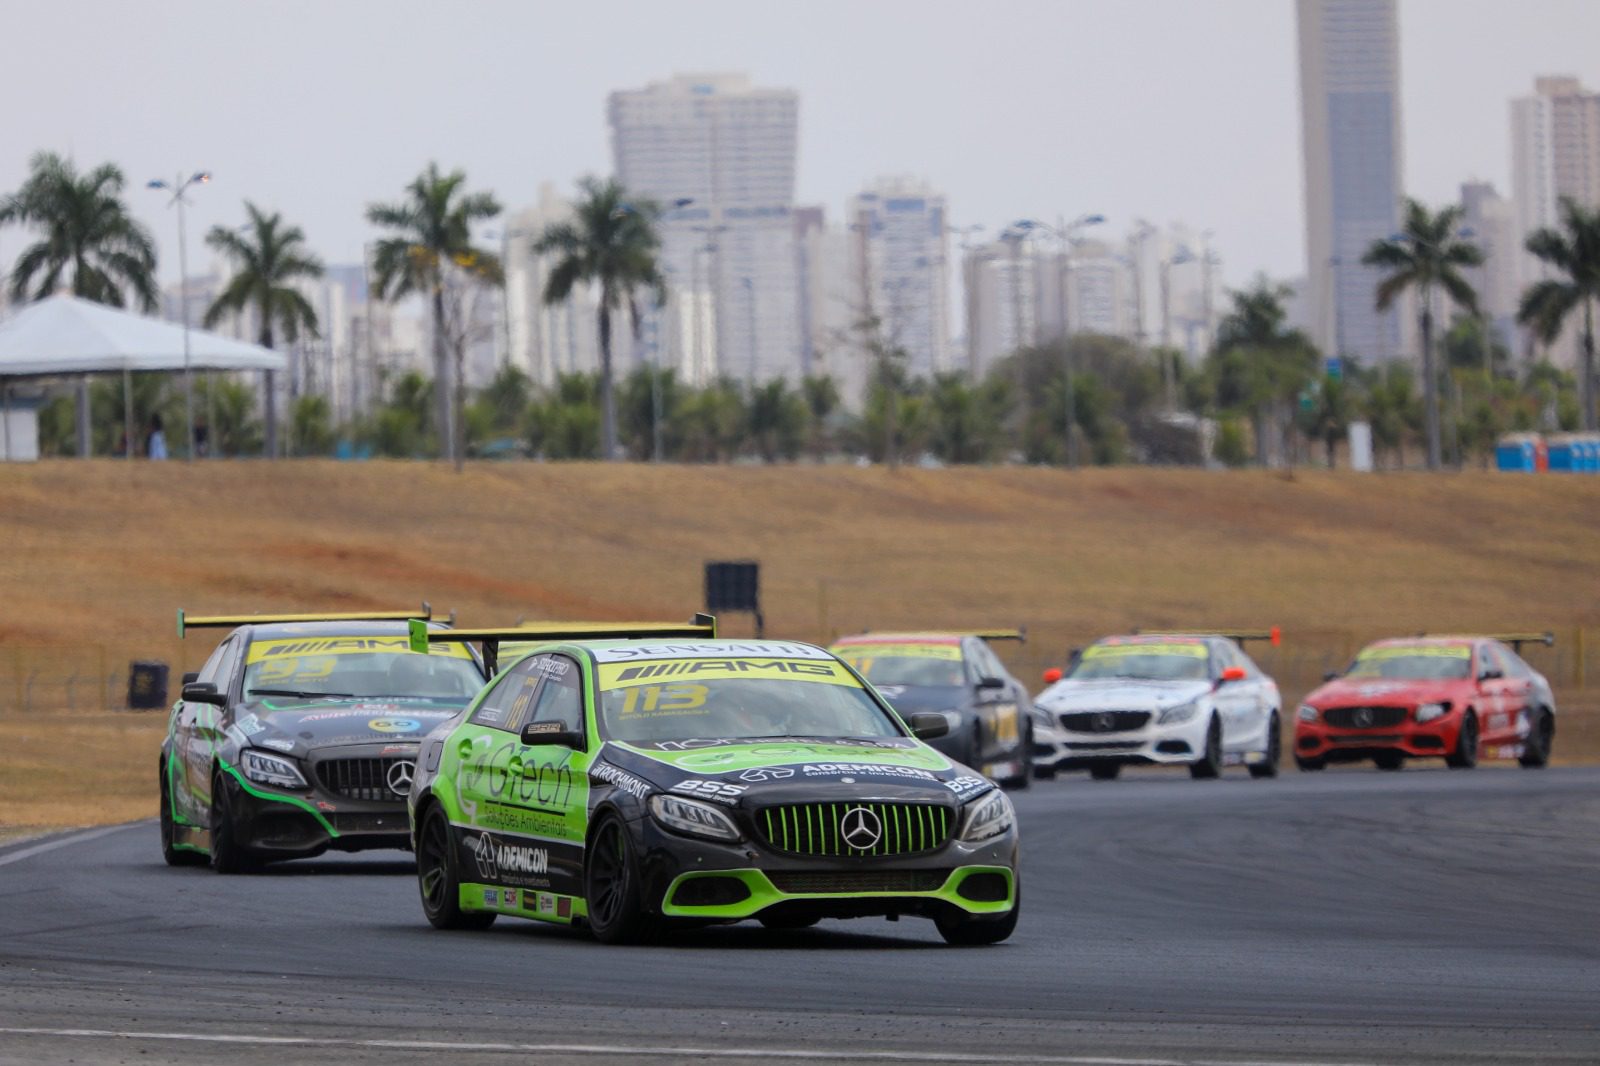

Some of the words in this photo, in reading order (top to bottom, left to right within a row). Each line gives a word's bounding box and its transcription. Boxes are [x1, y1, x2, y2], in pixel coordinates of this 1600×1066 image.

[687, 661, 836, 676] AMG
[622, 684, 709, 713] 113
[803, 763, 934, 779] ADEMICON
[673, 779, 749, 796] BSS
[944, 776, 983, 793] BSS
[497, 845, 548, 874] ADEMICON
